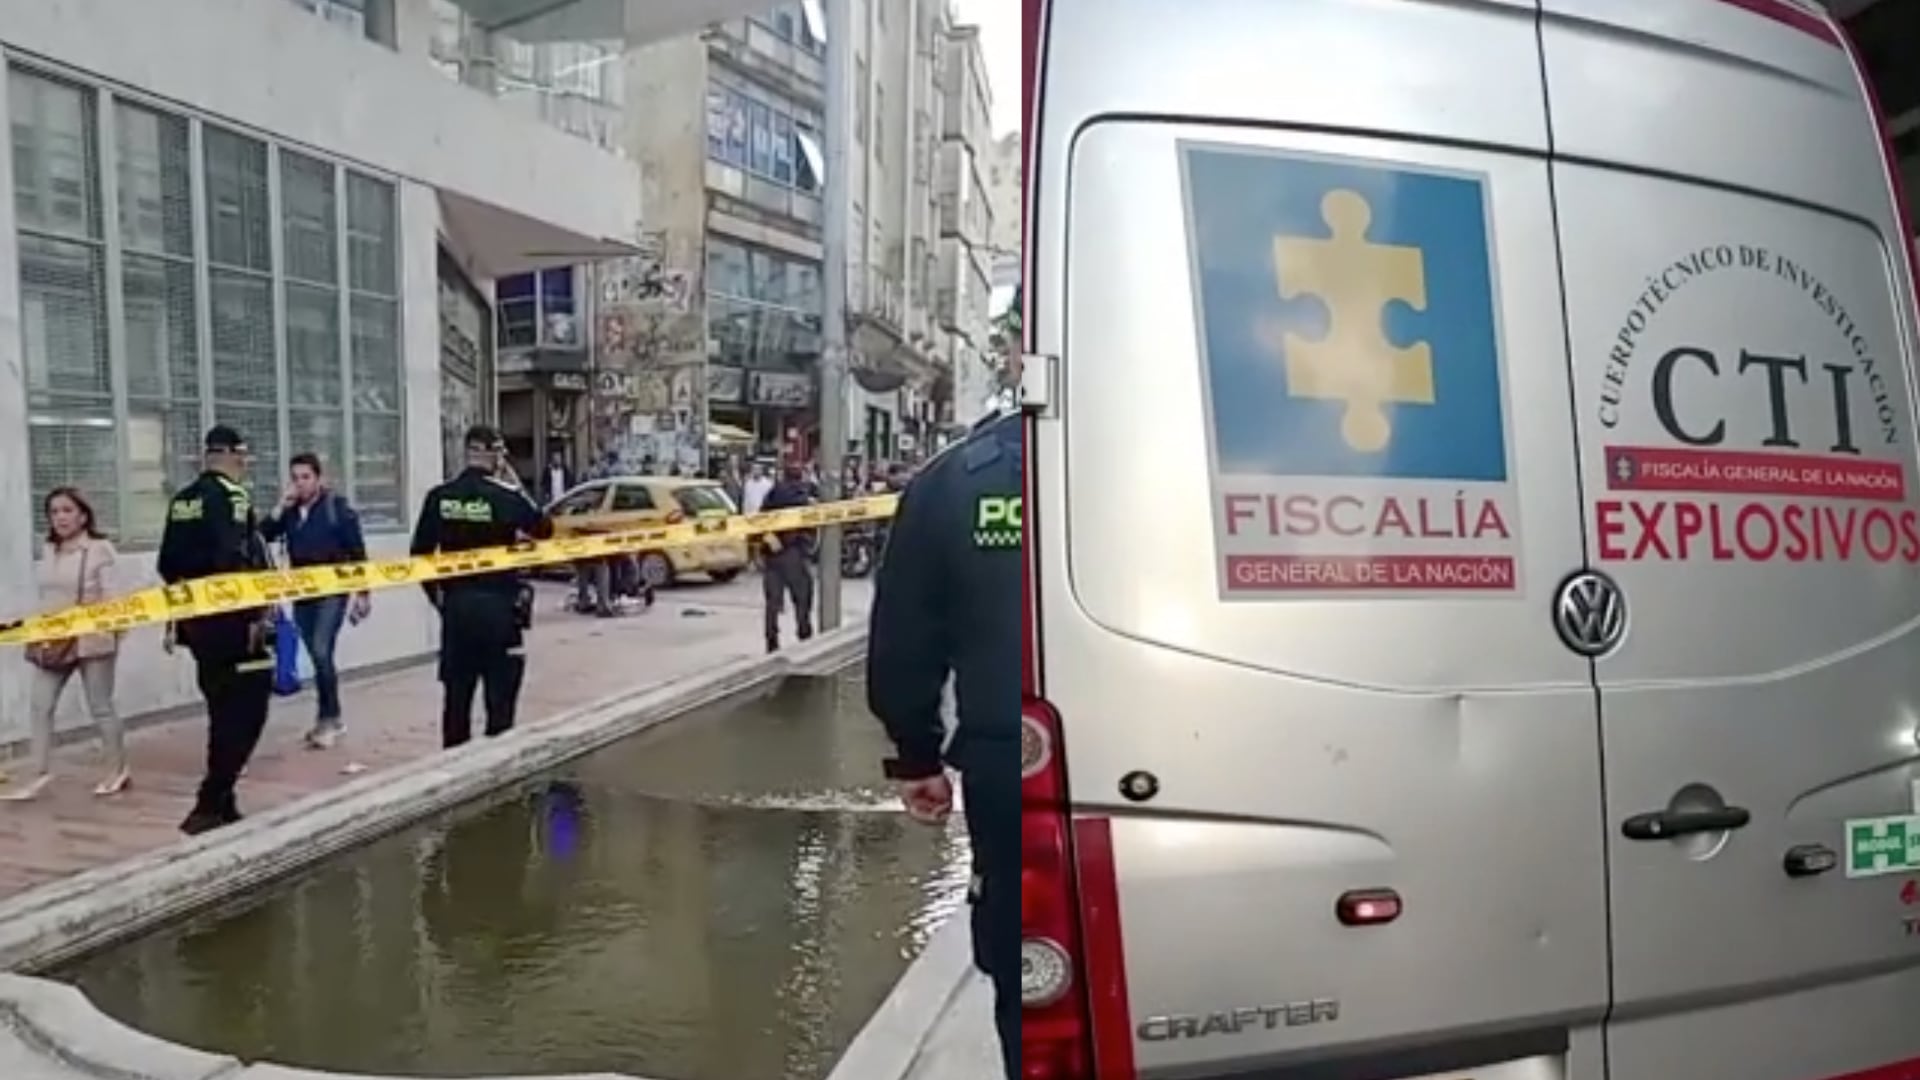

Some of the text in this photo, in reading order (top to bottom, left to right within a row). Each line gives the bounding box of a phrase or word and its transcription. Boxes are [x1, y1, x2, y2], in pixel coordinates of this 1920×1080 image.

[1739, 245, 1771, 272] DE
[1651, 346, 1861, 455] CTI
[1640, 460, 1720, 479] FISCALÍA
[1724, 466, 1799, 483] GENERAL
[1802, 469, 1824, 484] DE
[1825, 471, 1849, 486] LA
[1224, 489, 1510, 539] FISCALÍA
[1596, 500, 1920, 563] EXPLOSIVOS
[1236, 558, 1510, 583] GENERAL DE LA NACIÓN
[1137, 999, 1340, 1041] CRAFTER
